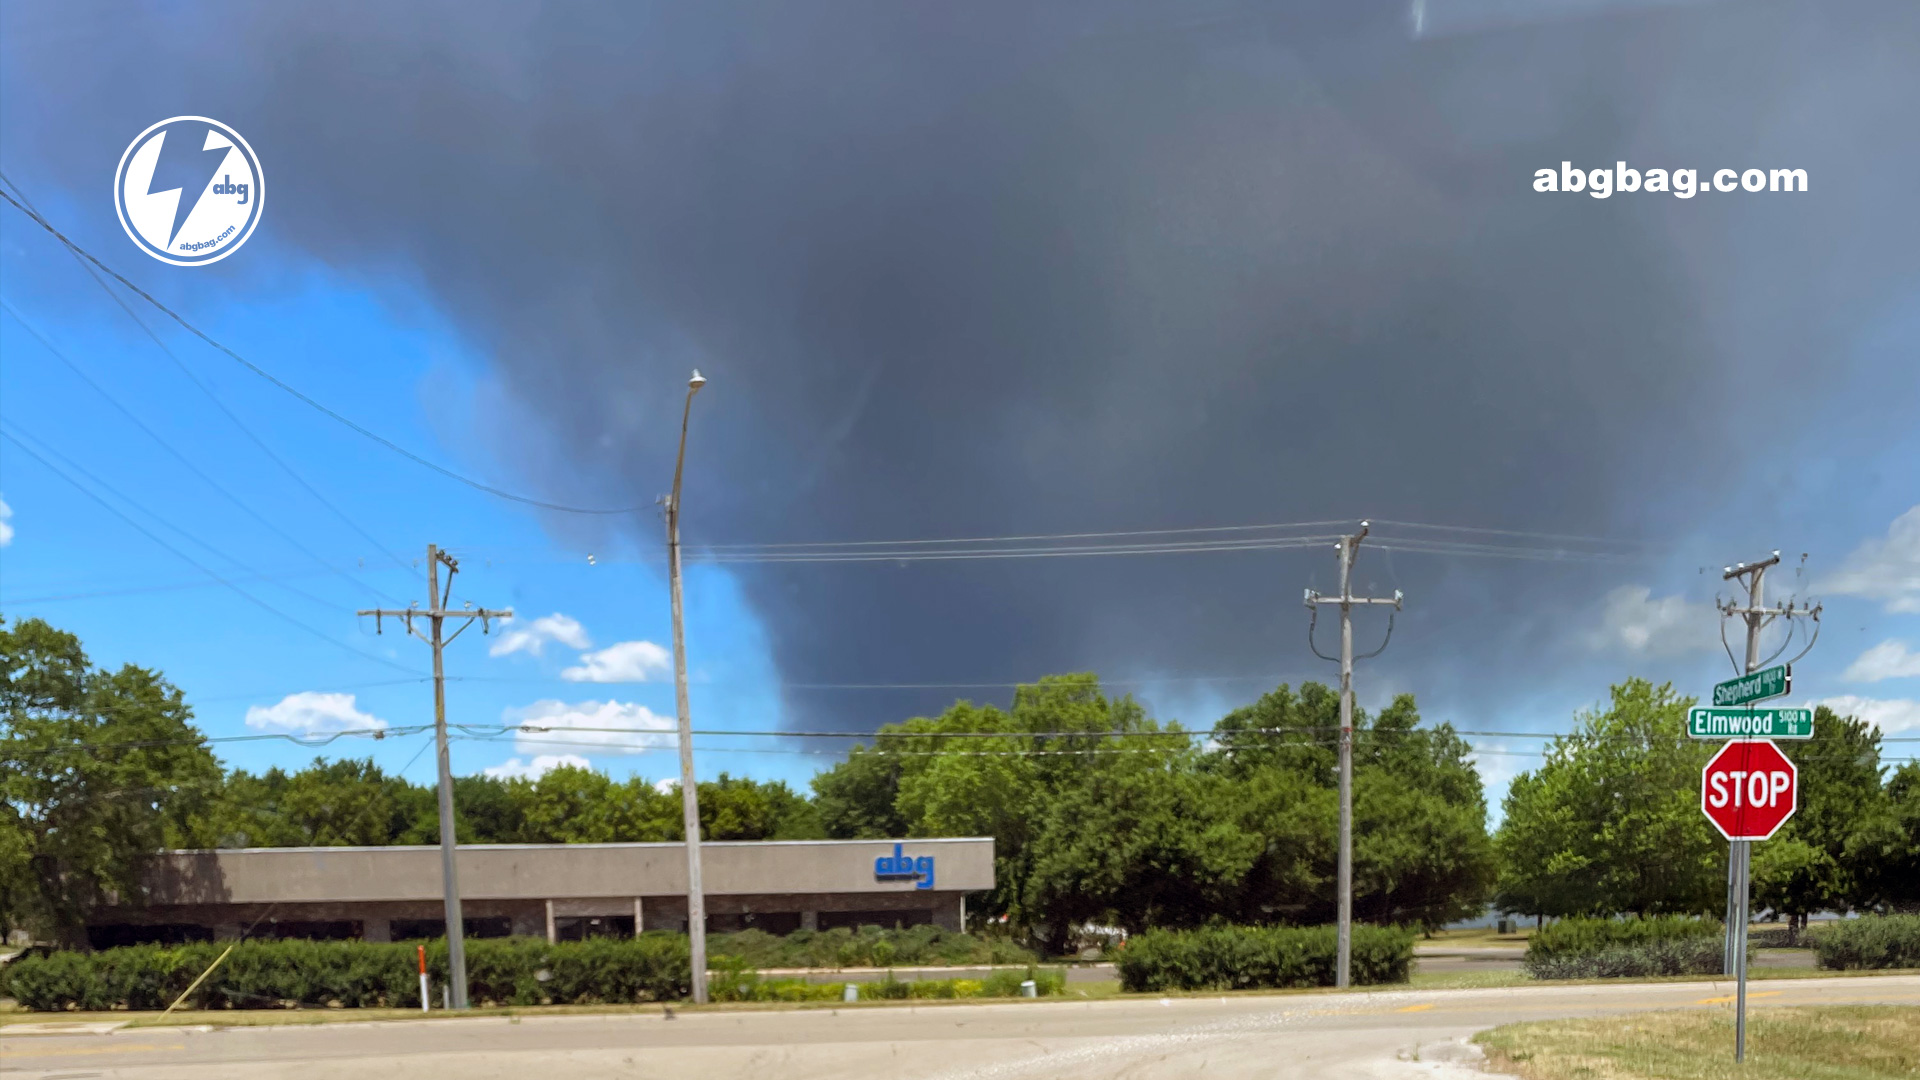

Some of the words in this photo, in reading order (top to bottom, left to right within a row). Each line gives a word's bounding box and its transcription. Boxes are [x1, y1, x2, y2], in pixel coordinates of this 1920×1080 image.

[1715, 674, 1761, 705] Shepherd
[1695, 711, 1773, 734] Elmwood
[1778, 710, 1798, 723] 5100
[1799, 710, 1806, 723] N
[1709, 770, 1790, 808] STOP
[875, 843, 935, 890] abg
